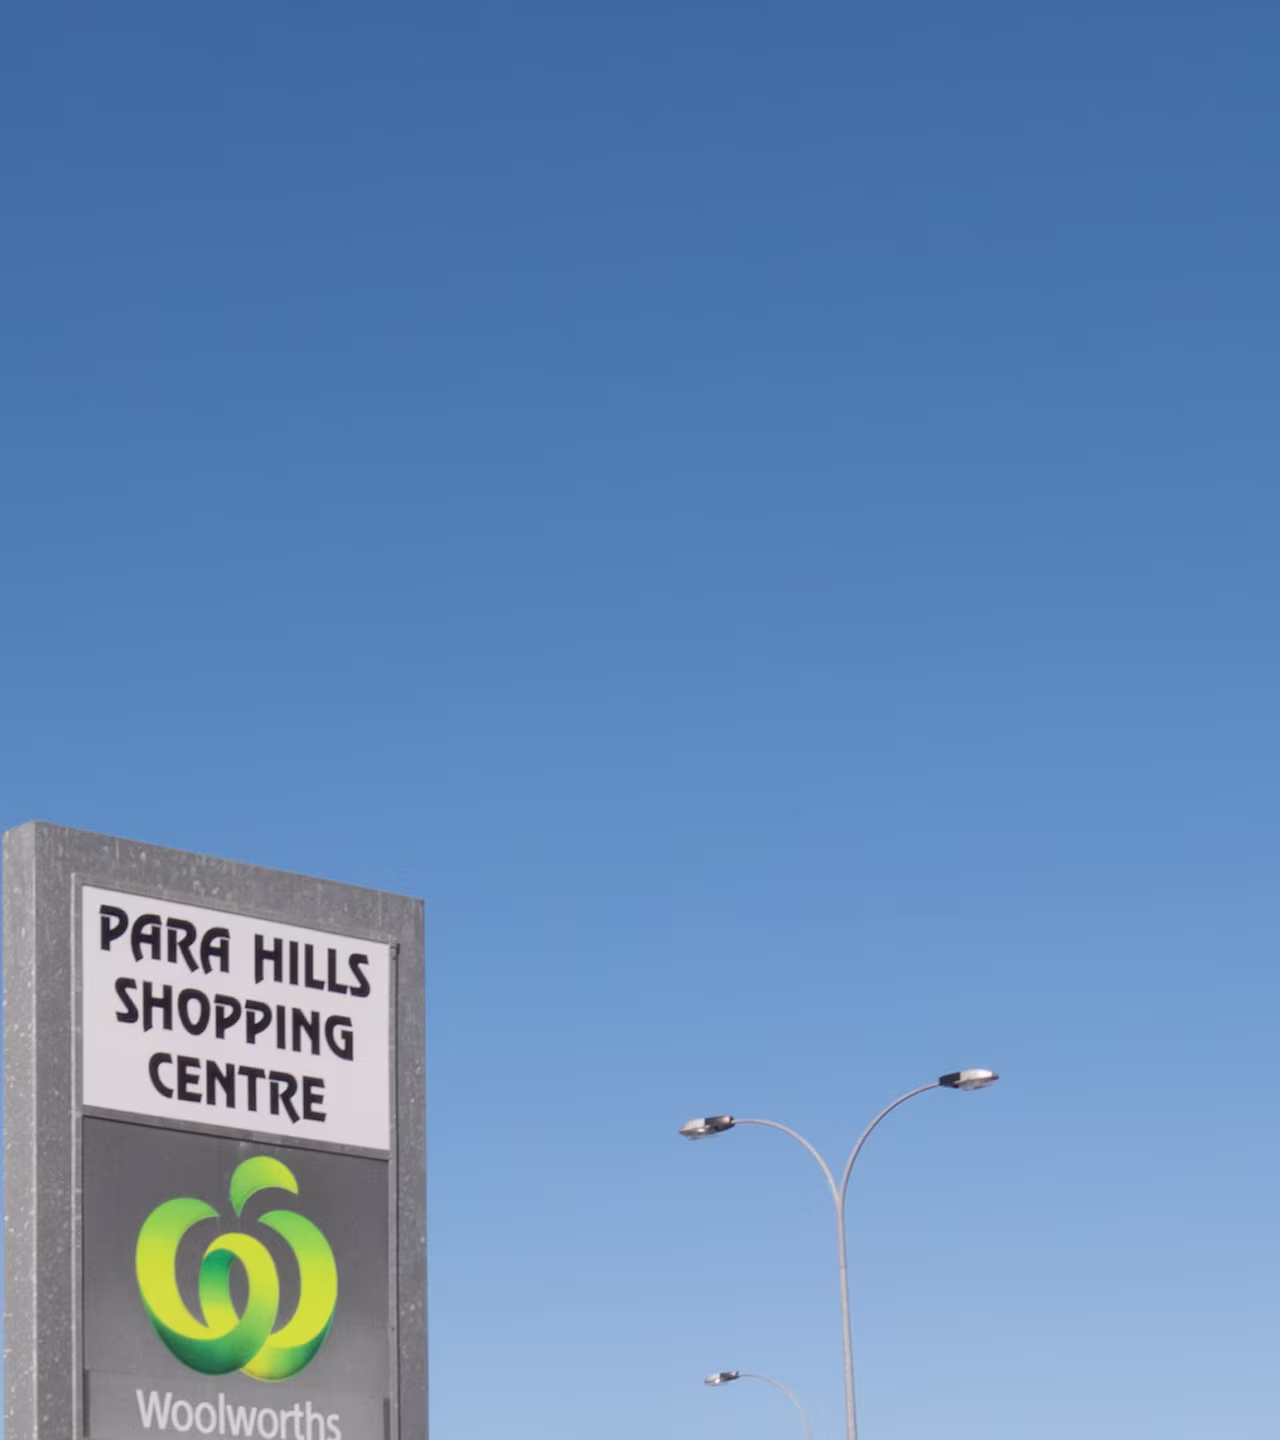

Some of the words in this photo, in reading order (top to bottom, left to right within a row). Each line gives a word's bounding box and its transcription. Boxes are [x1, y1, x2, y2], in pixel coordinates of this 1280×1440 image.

[100, 905, 230, 974] PARA
[254, 934, 372, 998] HILLS
[115, 977, 355, 1061] SHOPPING
[148, 1052, 327, 1124] CENTRE
